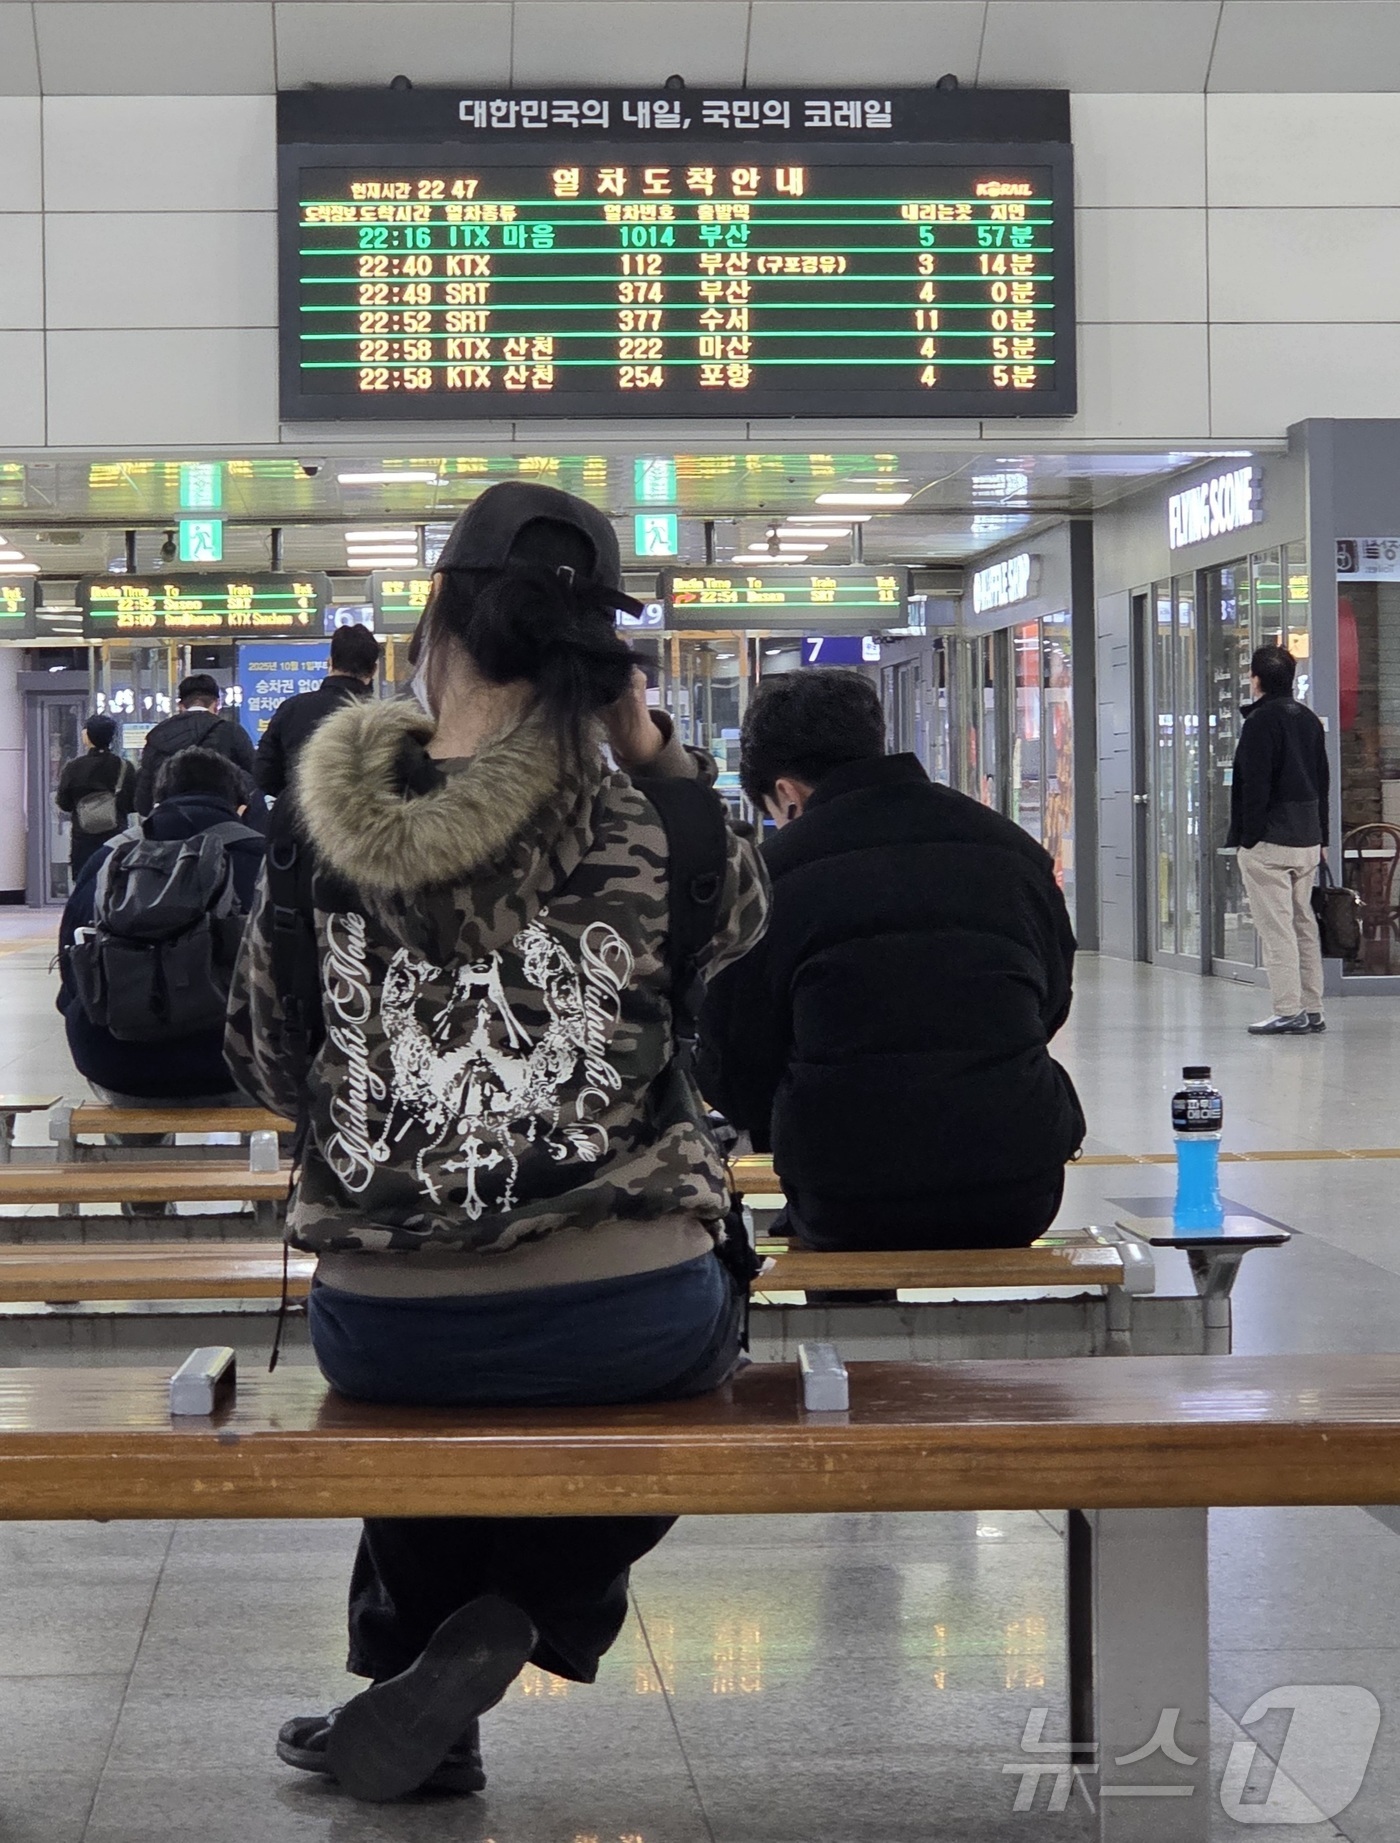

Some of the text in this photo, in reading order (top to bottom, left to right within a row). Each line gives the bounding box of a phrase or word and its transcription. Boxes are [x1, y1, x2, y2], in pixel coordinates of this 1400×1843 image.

[460, 99, 892, 128] 대한민국의 내일, 국민의 코레일
[351, 180, 478, 199] 현재시간 22 47
[976, 181, 1032, 197] KORAIL
[359, 204, 433, 221] 도착시간
[445, 205, 517, 221] 열차종류
[603, 204, 675, 220] 열차번호
[697, 204, 750, 220] 출발역
[901, 204, 973, 220] 내리는곳
[990, 204, 1026, 220] 지연
[358, 224, 1034, 248] 22:16 ITX 마음 1014 부산 5 57분
[360, 251, 1034, 276] 22:40 KTX 112 부산 (구포경유) 3 14분
[360, 280, 1035, 304] 22:49 SRT 374 부산 4 0분
[360, 308, 1035, 333] 22:52 SRT 377 수서 11 0분
[359, 336, 1035, 360] 22:58 KTX 산천 222 마산 4 5분
[359, 364, 1036, 389] 22:58 KTX 산천 254 포항 4 5분
[1210, 466, 1252, 536] SCONE
[646, 603, 662, 624] 9
[807, 637, 824, 661] 7
[256, 679, 294, 693] 승차권
[580, 921, 635, 1090] Midnight
[327, 1023, 386, 1193] Midnight
